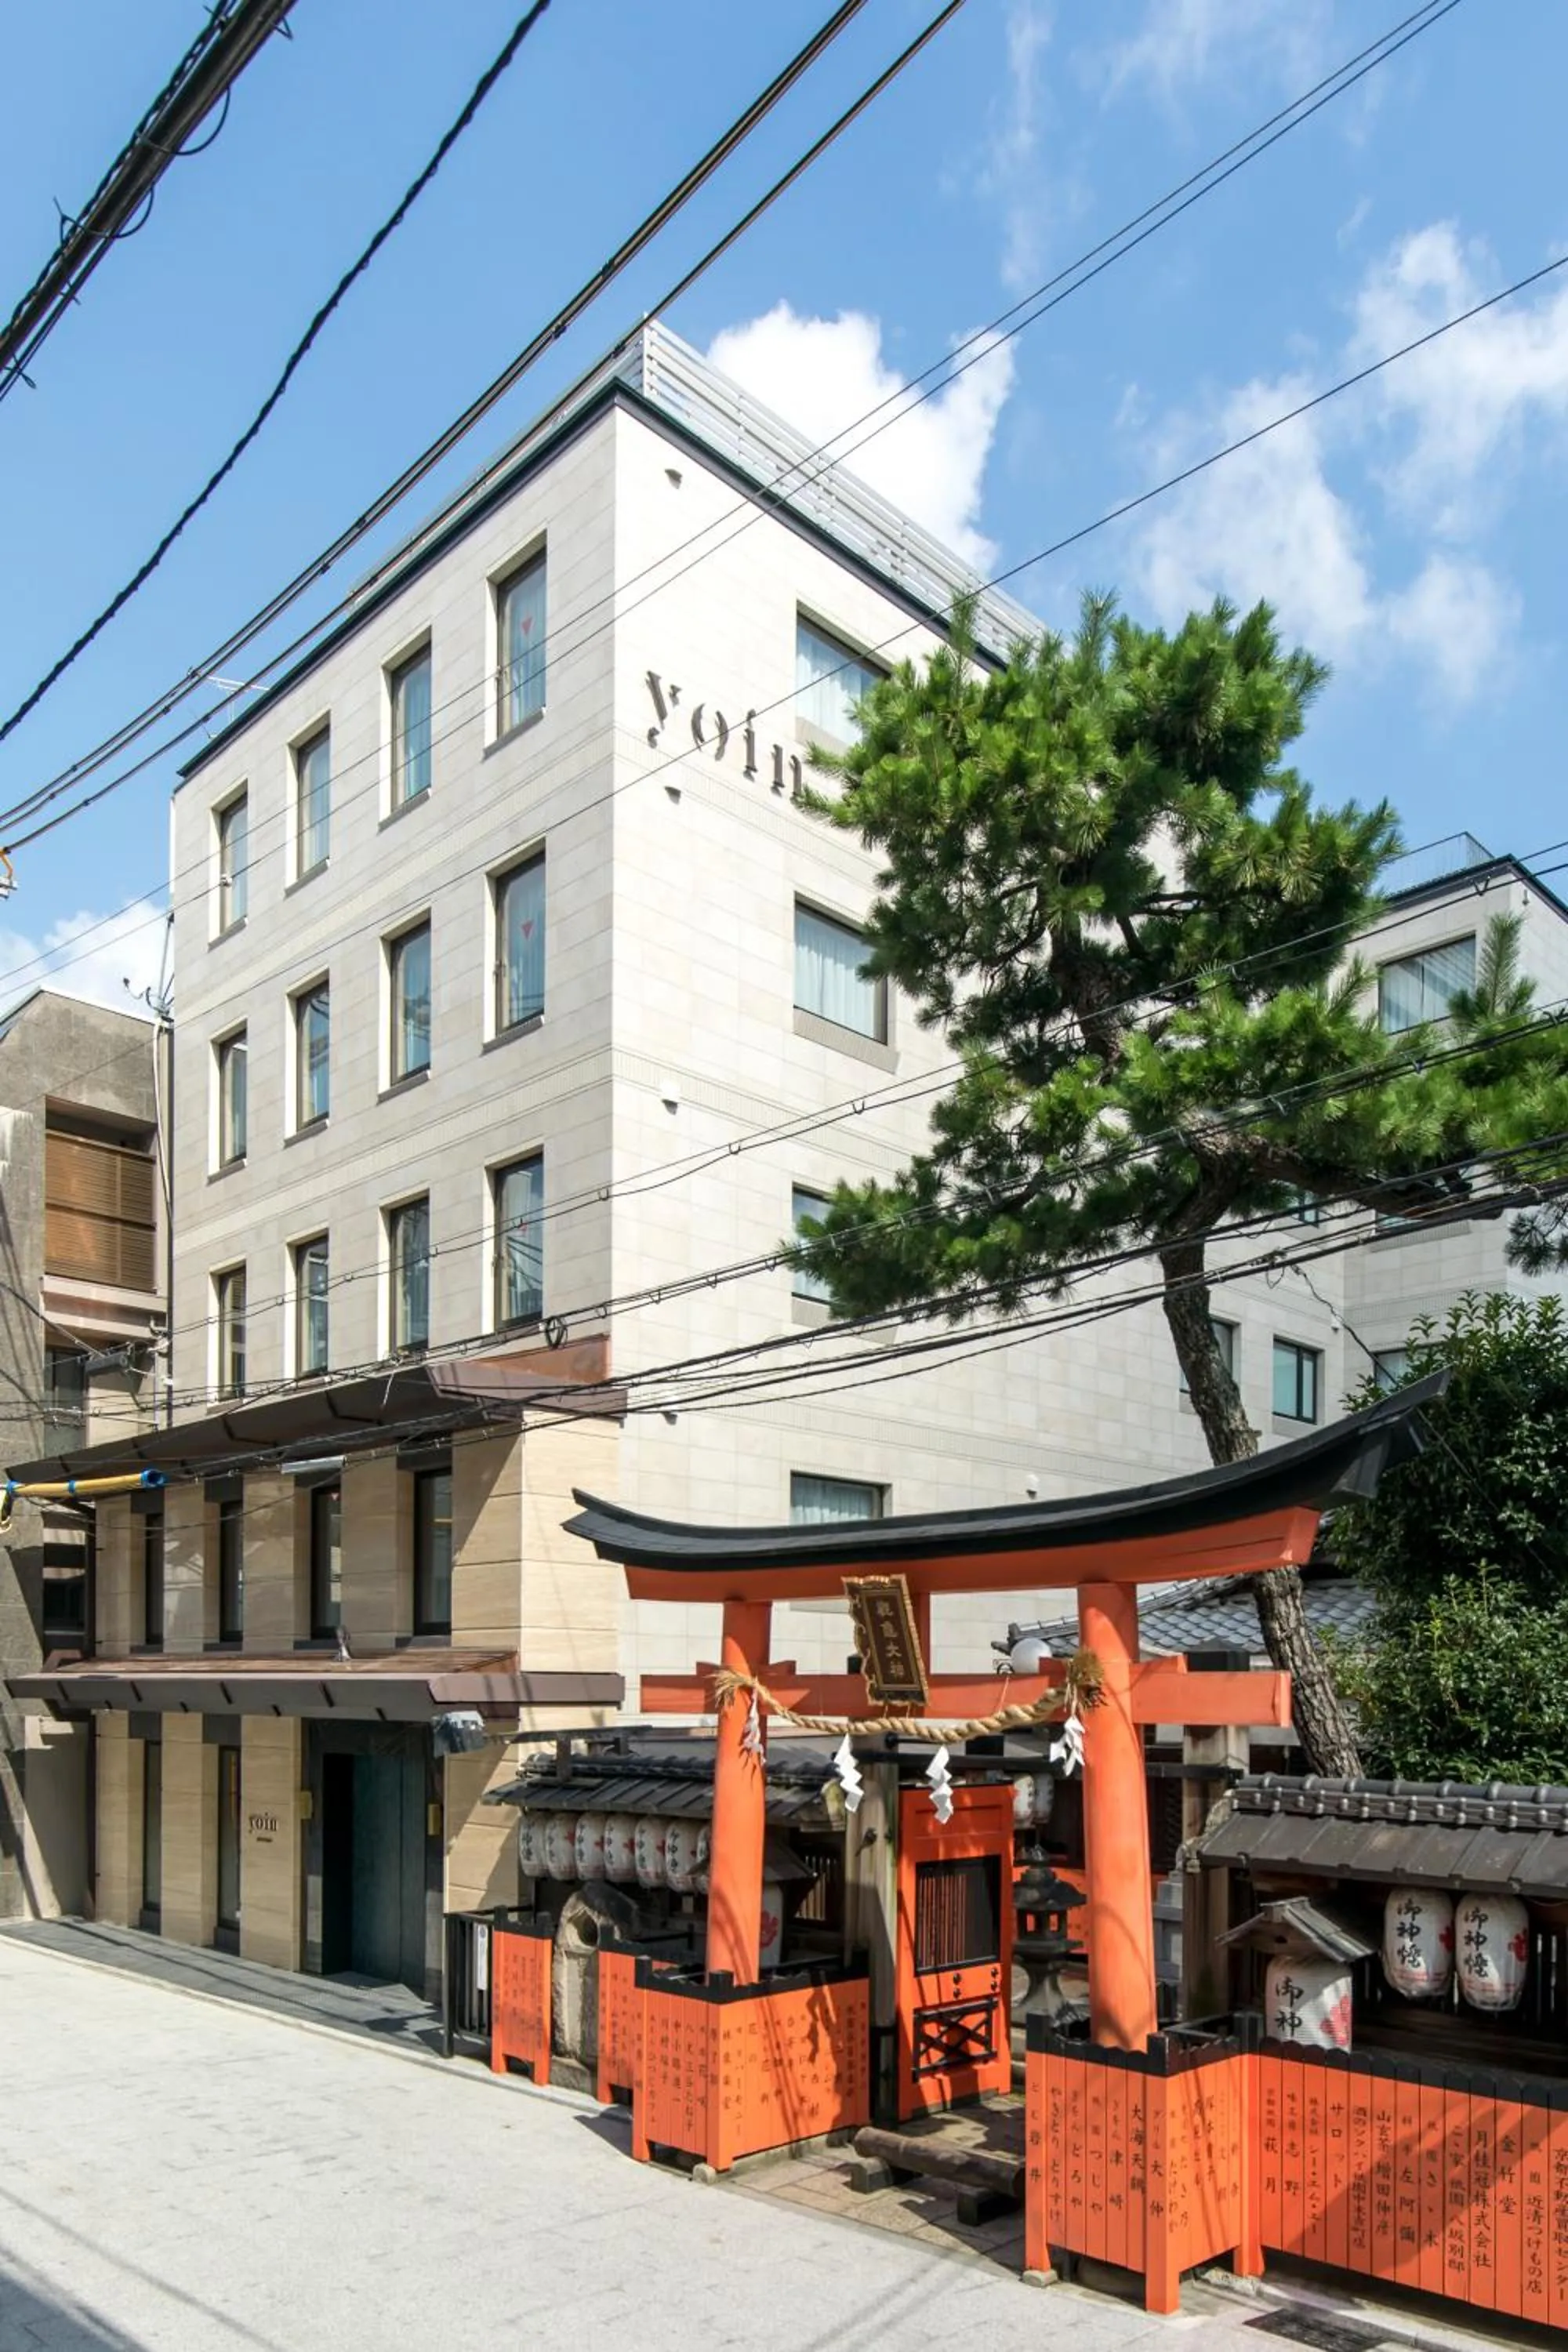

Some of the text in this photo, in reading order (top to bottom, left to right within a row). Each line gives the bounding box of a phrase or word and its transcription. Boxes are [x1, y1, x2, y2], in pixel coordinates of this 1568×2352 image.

[644, 670, 804, 800] yoin
[249, 1812, 277, 1835] yoin
[1473, 2129, 1493, 2269] 月桂冠株式会社
[1498, 2134, 1517, 2216] 金竹堂
